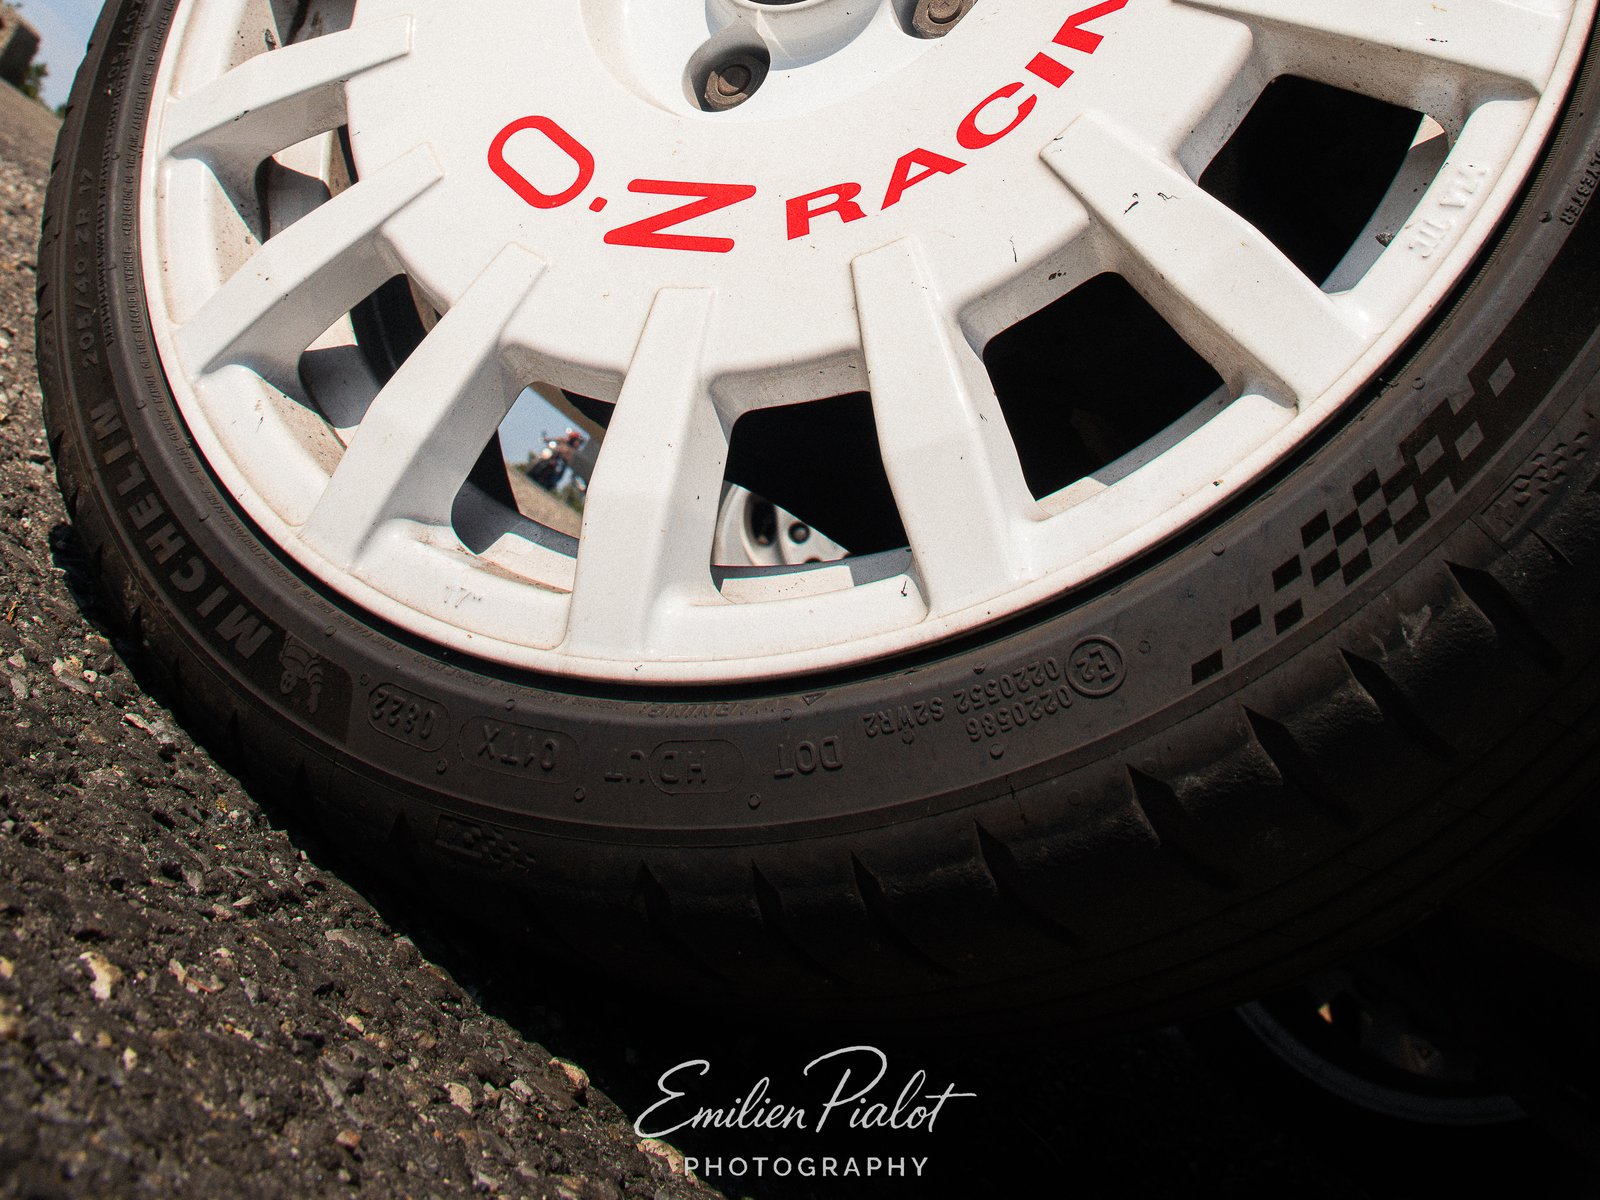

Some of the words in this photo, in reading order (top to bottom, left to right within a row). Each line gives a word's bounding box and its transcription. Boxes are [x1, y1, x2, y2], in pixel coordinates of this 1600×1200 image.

[78, 166, 93, 194] 17
[488, 116, 756, 253] O.Z
[1560, 149, 1600, 226] LYESTER
[73, 207, 90, 246] ZR
[71, 255, 101, 369] 205/40
[83, 397, 274, 662] MICHELIN
[951, 655, 1061, 716] 0220552
[1075, 643, 1115, 687] E2
[774, 735, 844, 778] DOT
